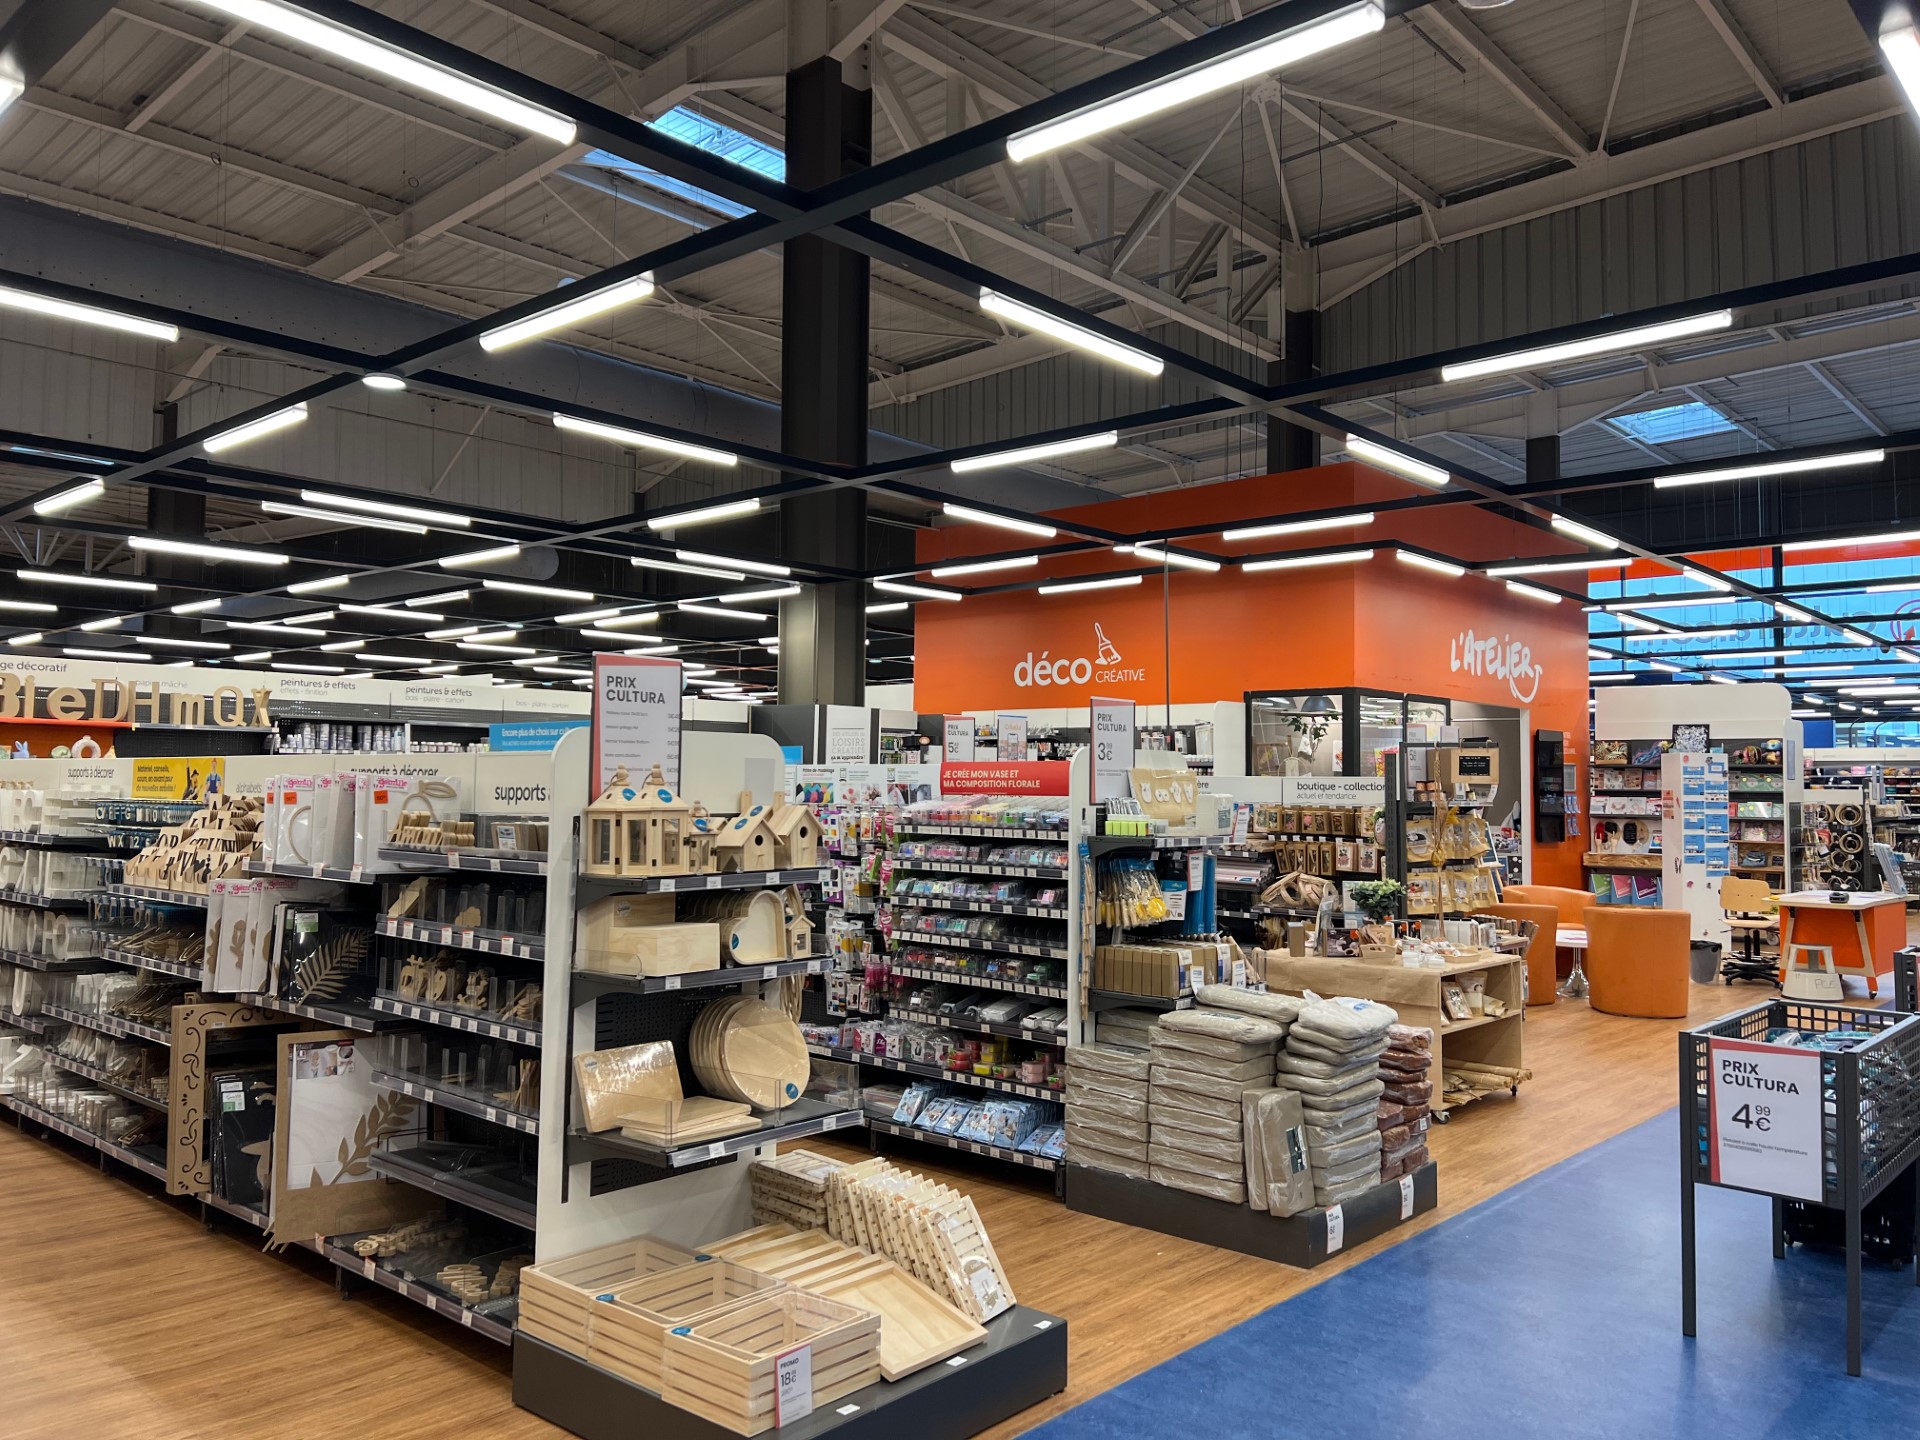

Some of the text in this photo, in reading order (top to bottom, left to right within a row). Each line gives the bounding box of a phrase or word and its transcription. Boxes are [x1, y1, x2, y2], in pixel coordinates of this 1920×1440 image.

[16, 661, 68, 672] décoratif
[1014, 650, 1092, 687] déco
[1096, 668, 1146, 683] CRÉATIVE
[280, 678, 322, 688] peintures
[332, 681, 356, 690] effets
[606, 676, 636, 688] PRIX
[405, 685, 442, 696] peintures
[606, 689, 665, 704] CULTURA
[1098, 713, 1112, 722] PRIX
[1097, 723, 1127, 732] CULTURA
[832, 738, 865, 747] LOISIRS
[948, 742, 954, 753] 5
[1098, 742, 1106, 760] 3
[1106, 751, 1112, 760] €
[68, 768, 89, 781] supports
[94, 766, 114, 778] décorer
[952, 768, 970, 778] CRÉE
[971, 770, 989, 778] MON
[236, 782, 262, 794] alphabets
[1008, 780, 1040, 788] FLORALE
[1297, 782, 1336, 792] boutique
[494, 784, 546, 805] supports
[1722, 1060, 1759, 1075] PRIX
[1722, 1073, 1799, 1095] CULTURA
[1732, 1104, 1771, 1129] 4 99
[1755, 1117, 1771, 1131] €
[781, 1358, 799, 1369] PROMO
[781, 1371, 791, 1387] 18
